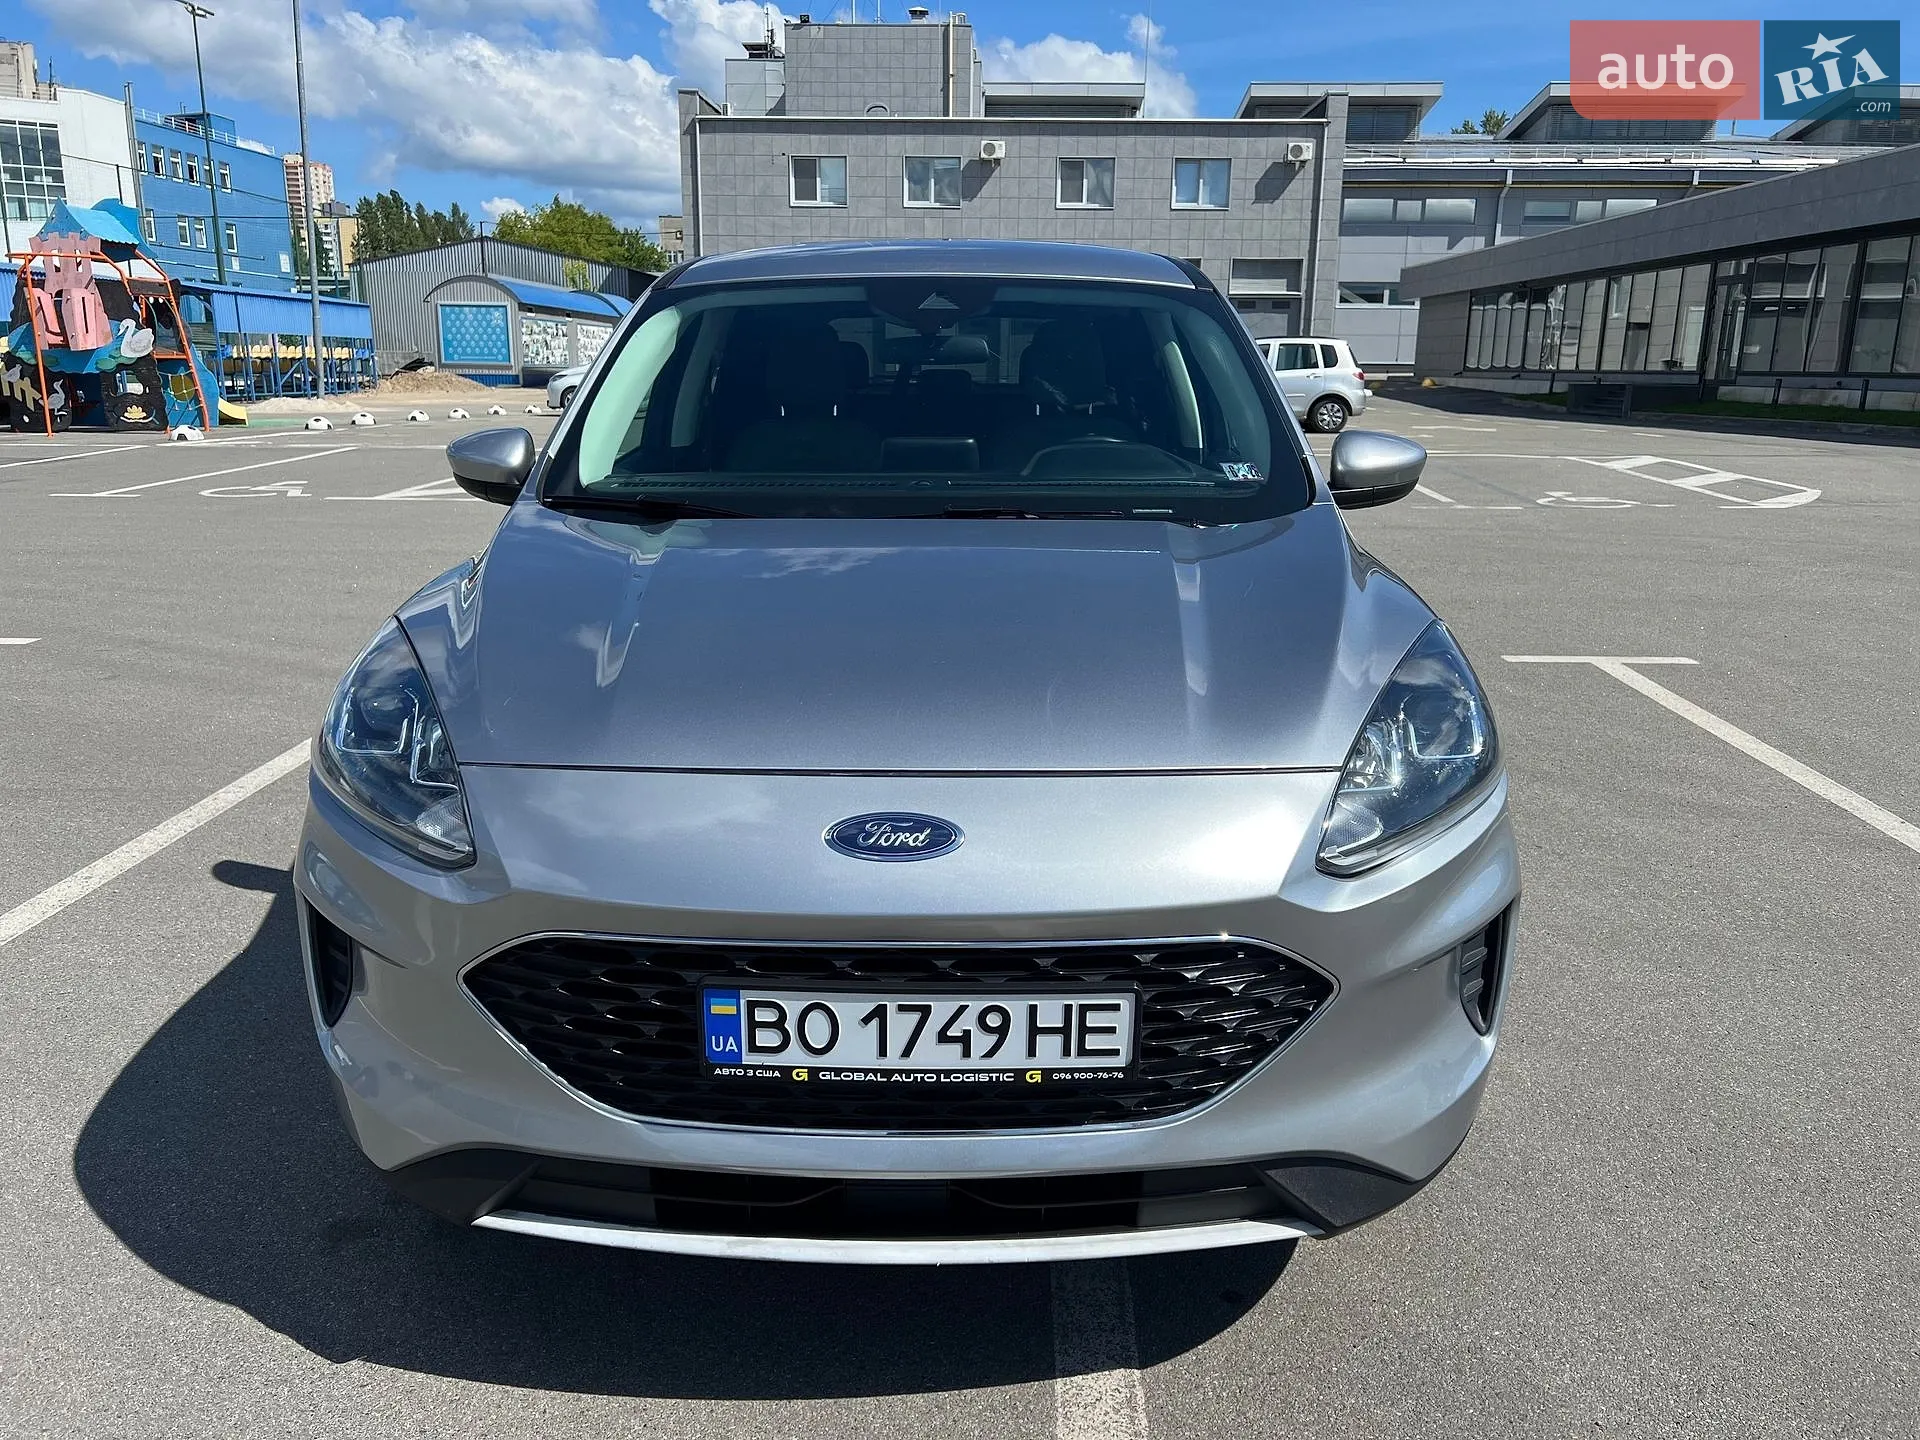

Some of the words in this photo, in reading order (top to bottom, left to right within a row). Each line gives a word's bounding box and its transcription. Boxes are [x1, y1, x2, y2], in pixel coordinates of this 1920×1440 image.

[857, 820, 932, 847] Ford
[745, 998, 840, 1056] BO
[858, 1002, 1012, 1059] 1749
[1027, 1003, 1121, 1058] HE
[711, 1035, 738, 1053] UA
[713, 1067, 745, 1077] АВТО
[755, 1069, 781, 1078] США
[818, 1071, 887, 1082] GLOBAL
[890, 1073, 937, 1083] AUTO
[940, 1072, 1015, 1083] LOGISTIC
[1052, 1072, 1072, 1080] 096
[1073, 1071, 1124, 1080] 900-76-76
